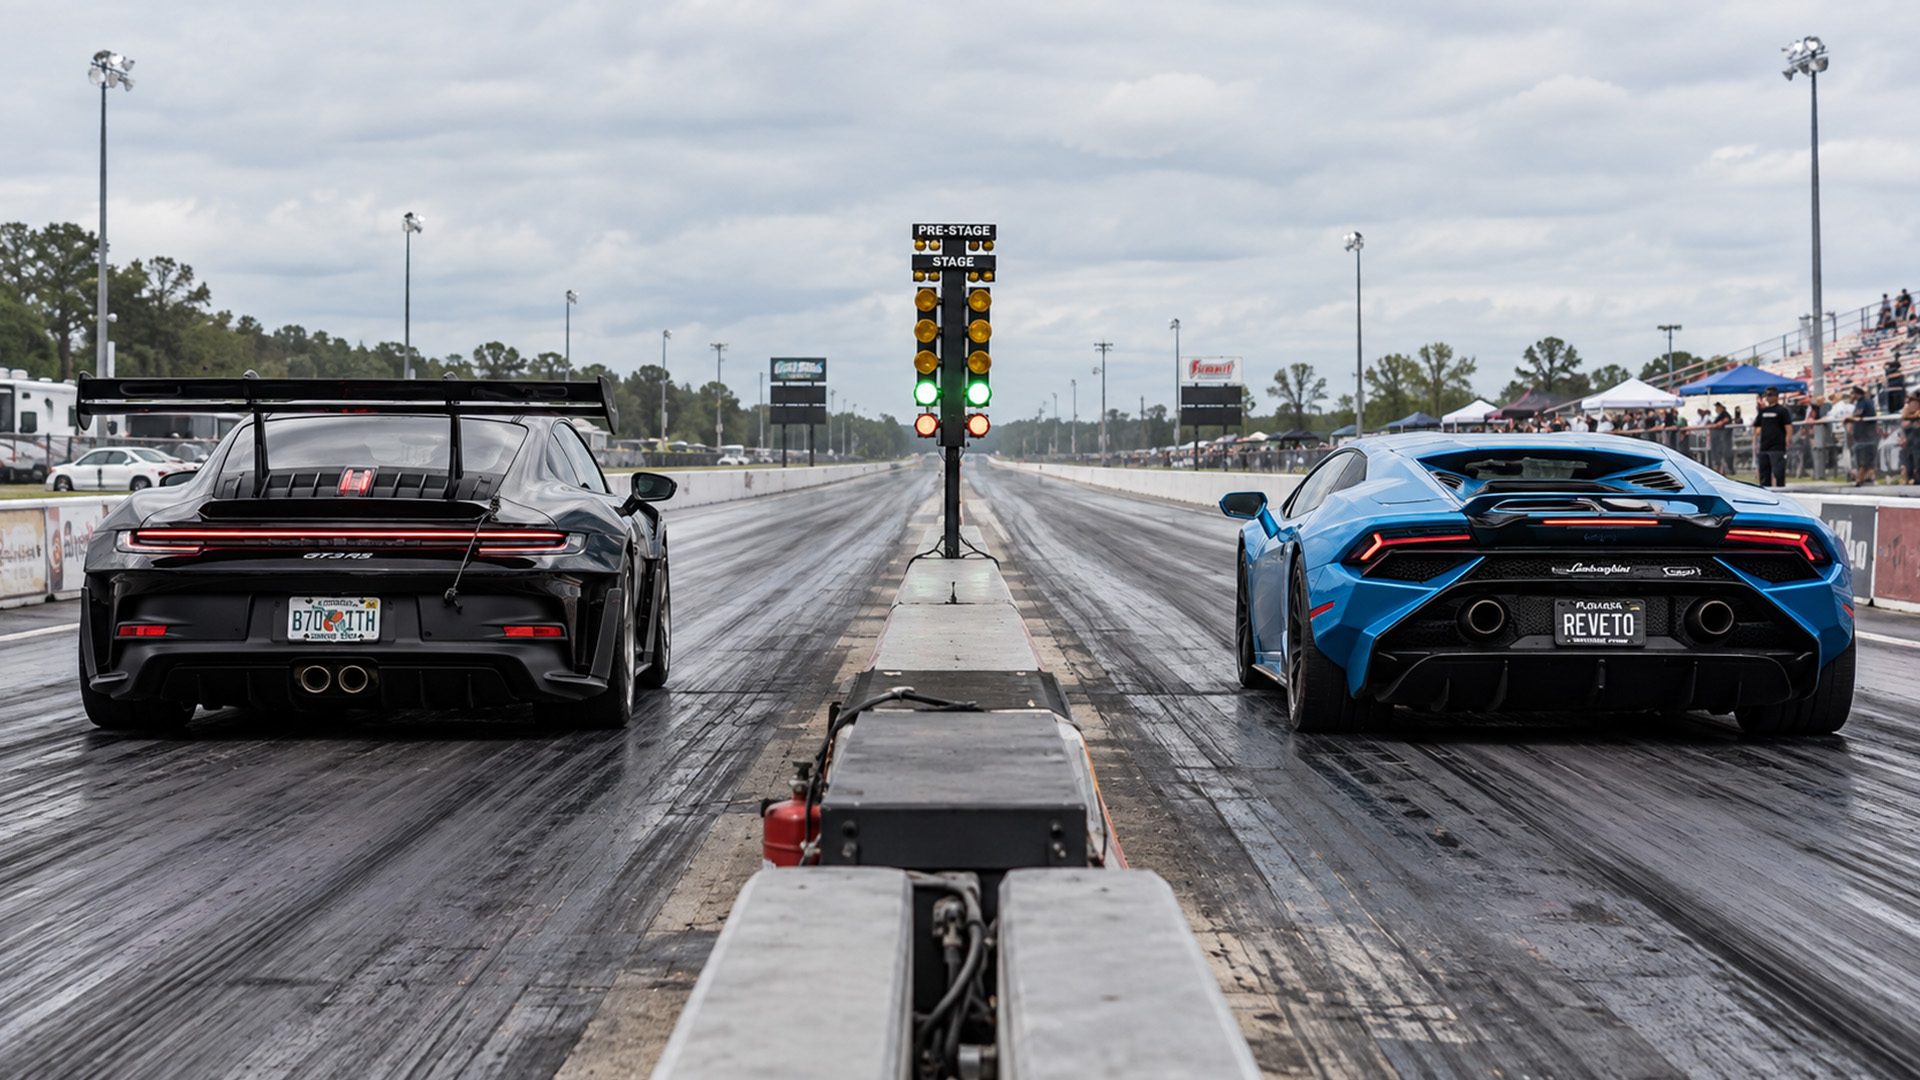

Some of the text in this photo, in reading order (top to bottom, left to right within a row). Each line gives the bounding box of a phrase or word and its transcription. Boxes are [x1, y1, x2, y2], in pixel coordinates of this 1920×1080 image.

[918, 225, 990, 236] PRE-STAGE
[932, 256, 975, 267] STAGE
[1563, 613, 1635, 637] REVETO
